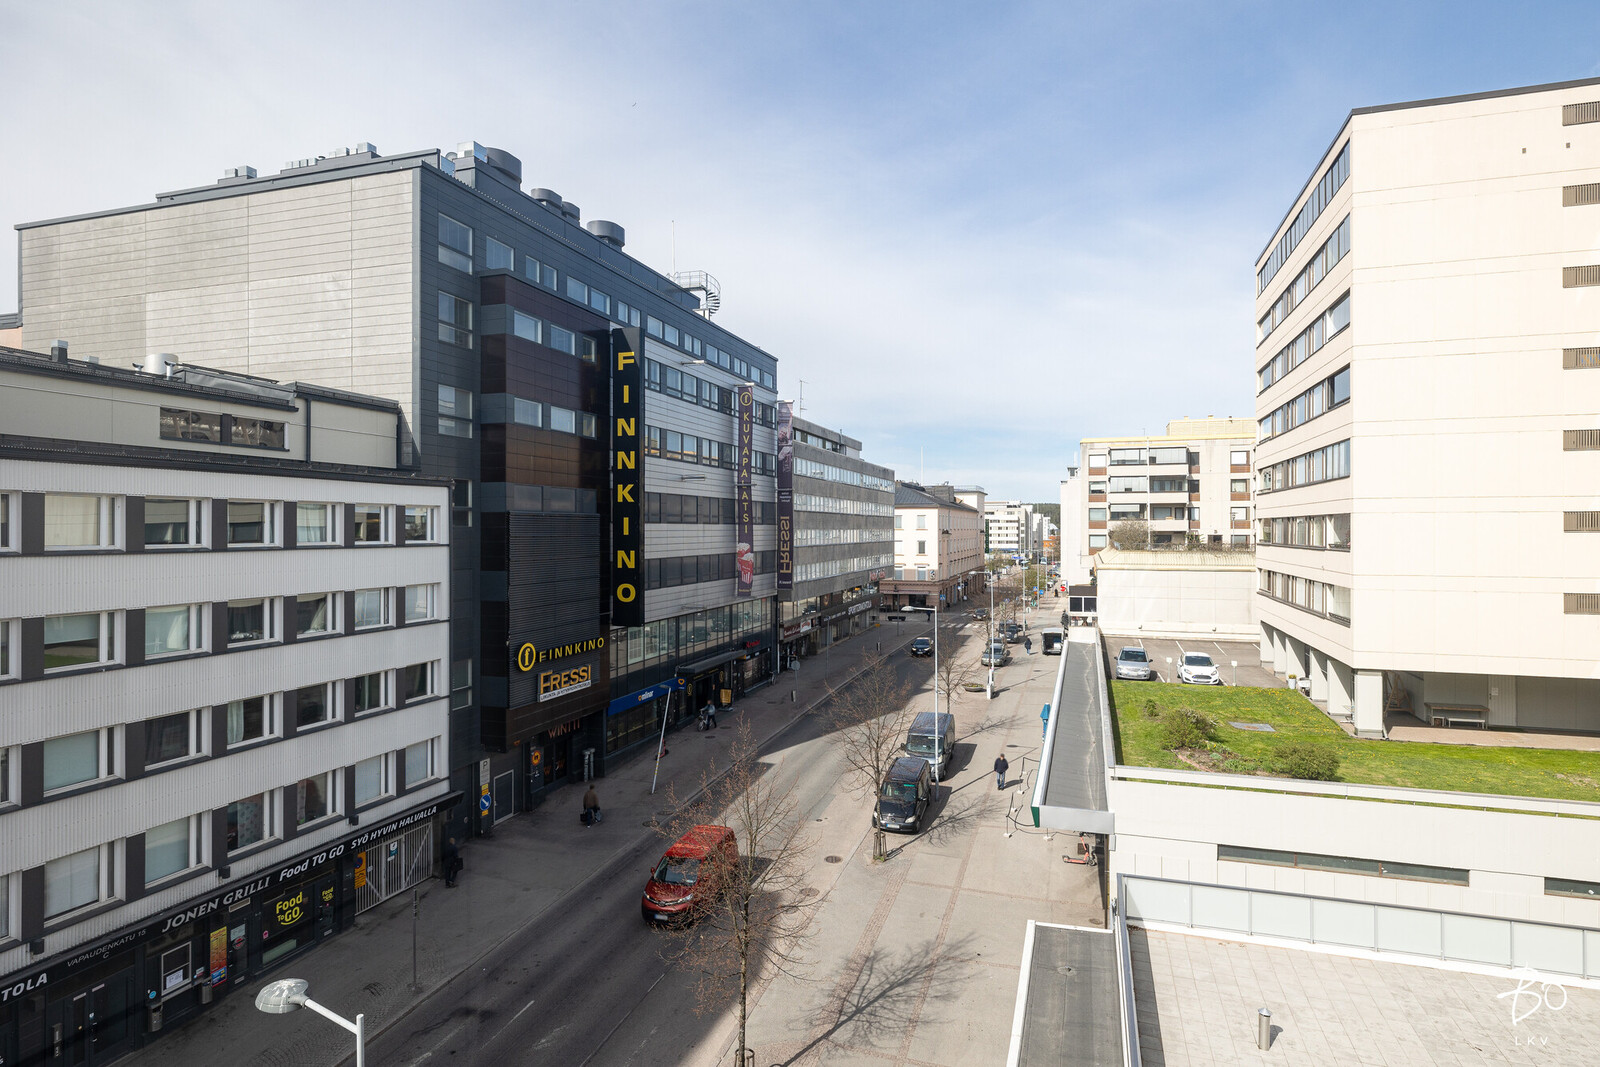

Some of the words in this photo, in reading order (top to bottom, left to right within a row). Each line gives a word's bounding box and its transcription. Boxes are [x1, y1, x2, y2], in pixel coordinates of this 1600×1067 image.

[617, 351, 636, 603] FINNKINO
[539, 637, 604, 662] FINNKINO
[540, 664, 591, 694] FRESSI
[351, 833, 369, 849] SYÖ
[370, 824, 397, 842] HYVIN
[399, 805, 437, 828] HALVALLA
[279, 861, 309, 882] Food
[312, 852, 326, 868] TO
[329, 844, 345, 859] GO
[162, 898, 220, 933] JONEN
[223, 876, 271, 905] GRILLI
[276, 892, 303, 914] Food
[284, 907, 300, 922] GO
[67, 933, 136, 967] VAPAUDENKATU
[1, 972, 48, 1002] TOLA
